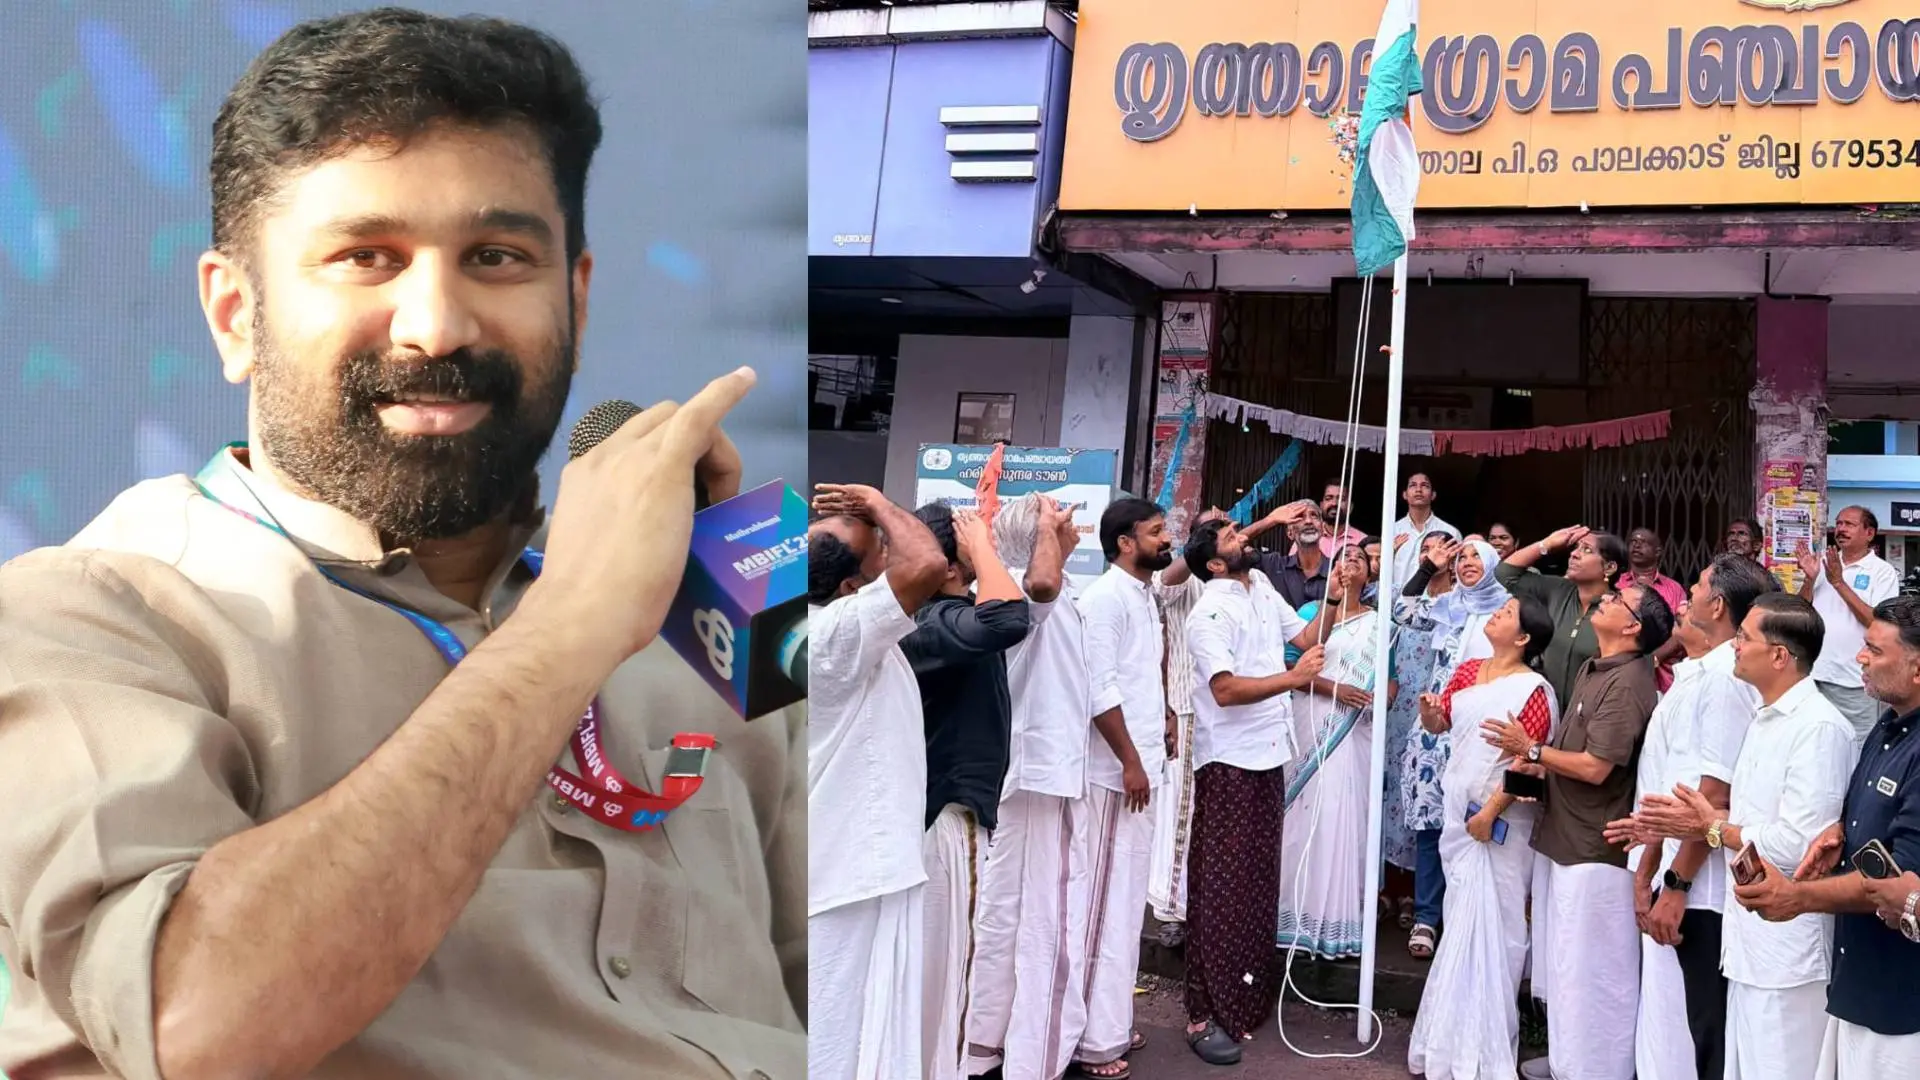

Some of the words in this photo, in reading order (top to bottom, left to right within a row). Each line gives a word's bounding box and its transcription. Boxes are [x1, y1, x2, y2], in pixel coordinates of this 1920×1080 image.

[1571, 134, 1731, 173] പാലക്കാട്
[1738, 134, 1800, 179] ജില്ല
[1811, 138, 1920, 169] 679534
[576, 705, 605, 778] MBIFL'2
